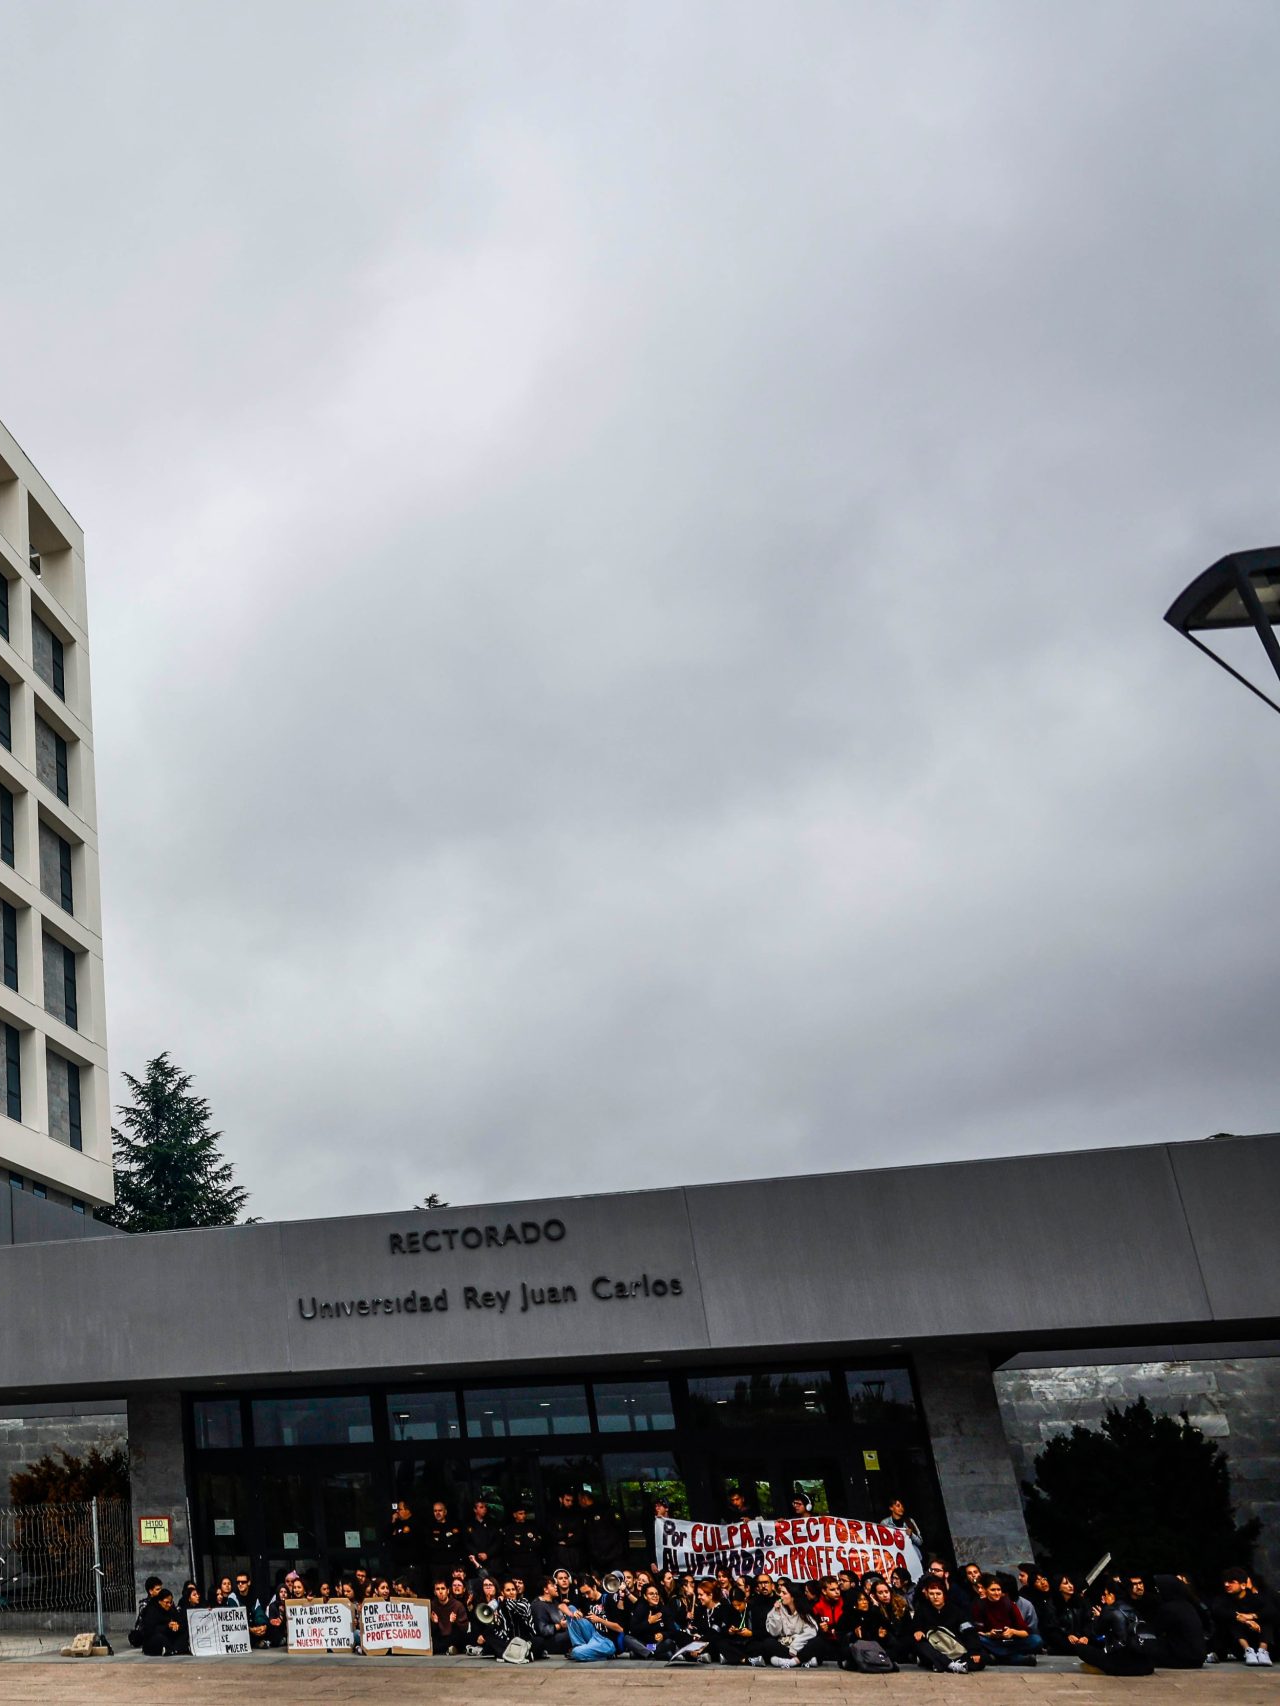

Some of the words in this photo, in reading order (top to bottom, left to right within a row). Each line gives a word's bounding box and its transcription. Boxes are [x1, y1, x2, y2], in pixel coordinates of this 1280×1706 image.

[389, 1218, 566, 1254] RECTORADO
[298, 1288, 448, 1320] Universidad
[463, 1286, 510, 1313] Rey
[520, 1281, 577, 1312] Juan
[591, 1274, 683, 1300] Carlos
[662, 1520, 687, 1547] Por
[691, 1523, 754, 1552] CULPA
[755, 1522, 774, 1547] de
[775, 1516, 905, 1551] RECTORADO
[289, 1607, 297, 1616] NI
[309, 1605, 339, 1616] BUITRES
[363, 1604, 379, 1616] POR
[385, 1603, 412, 1614] CULPA
[217, 1610, 245, 1622] NUESTRA
[295, 1617, 304, 1625] NI
[306, 1615, 342, 1625] CORRUPTOS
[364, 1616, 376, 1624] DEL
[378, 1614, 414, 1622] RECTORADO
[365, 1621, 404, 1632] ESTUDIANTES
[407, 1620, 419, 1628] SIN
[295, 1629, 305, 1638] LA
[328, 1627, 338, 1636] ES
[366, 1629, 422, 1643] PROFESORADO
[221, 1634, 230, 1643] SE
[296, 1638, 323, 1648] NUESTRA
[324, 1639, 329, 1647] Y
[225, 1643, 249, 1654] MUERE
